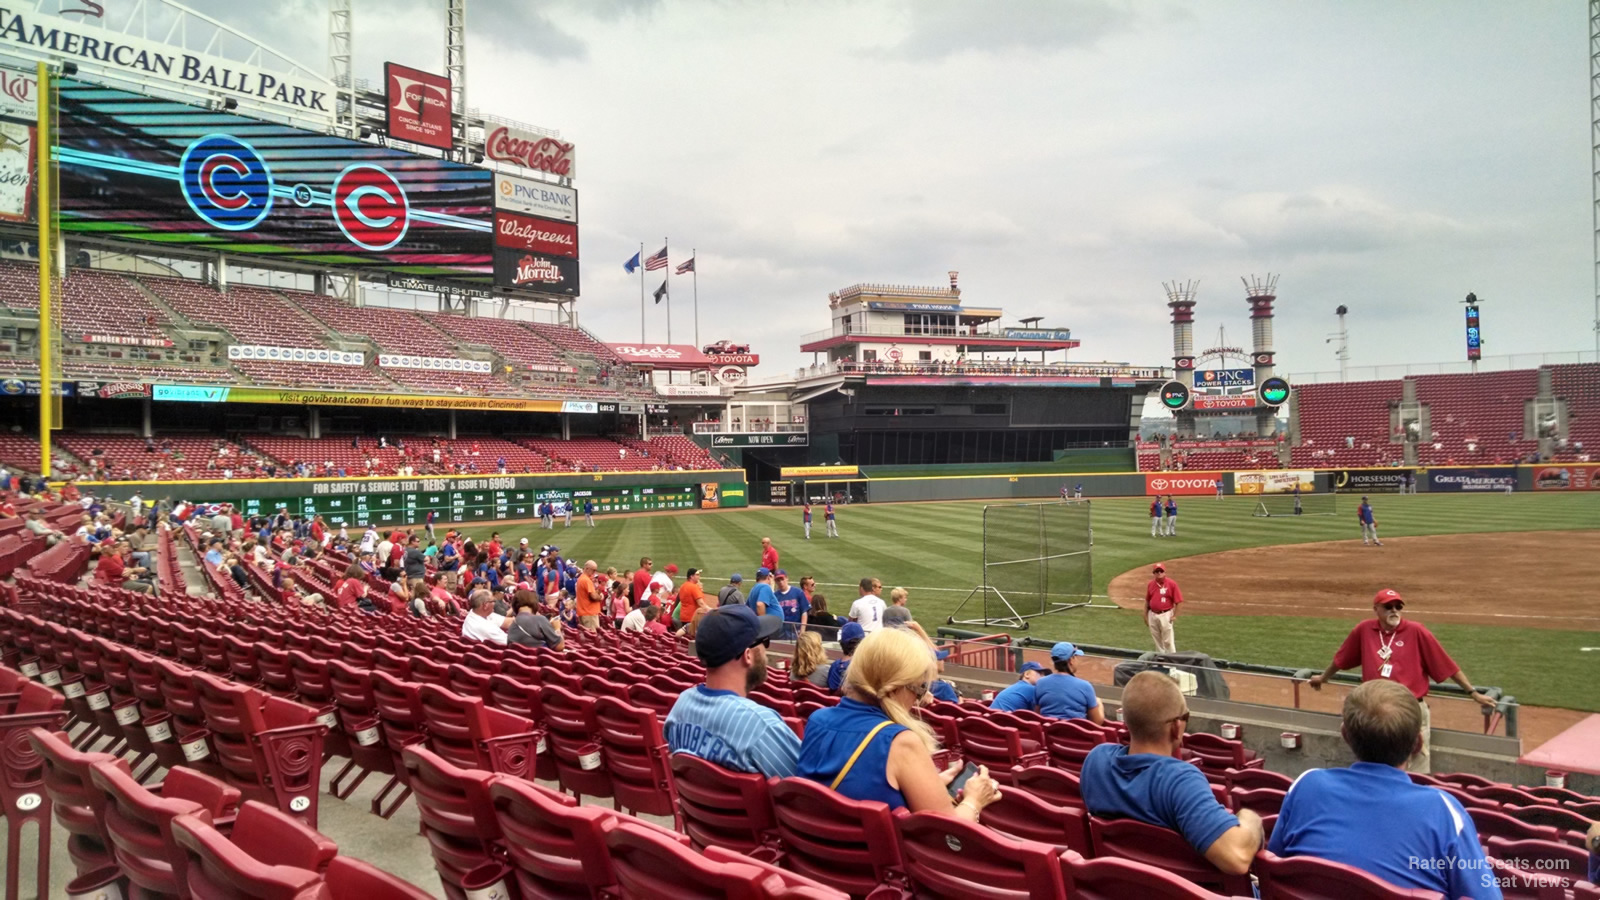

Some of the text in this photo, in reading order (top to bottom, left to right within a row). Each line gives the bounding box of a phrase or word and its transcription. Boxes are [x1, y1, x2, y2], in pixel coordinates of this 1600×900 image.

[0, 14, 329, 113] AMERICAN BALL PARK
[398, 116, 443, 131] CINCINATIANS
[405, 124, 423, 133] SINCE
[486, 126, 576, 176] Coca-Cola
[296, 190, 310, 198] VS
[514, 184, 572, 207] PNC BANK
[498, 218, 574, 245] Walgreens
[530, 257, 551, 269] John
[512, 265, 564, 284] Morrell
[390, 280, 490, 298] ULTIMATE AIR SHUTTLE
[92, 335, 120, 343] KROGER
[1006, 328, 1071, 340] Cincinnati Bell
[615, 346, 682, 357] Reds
[719, 355, 754, 363] TOYOTA
[1216, 370, 1244, 381] PNC
[279, 392, 527, 409] Visit govibrant.com for fun ways to stay active in Cincinnati!
[748, 435, 774, 444] NOW OPEN
[1169, 479, 1216, 489] TOYOTA
[1434, 474, 1505, 485] GREAT AMERICA
[313, 483, 329, 494] FOR
[330, 482, 360, 494] SAFETY
[360, 484, 367, 492] &
[367, 482, 400, 492] SERVICE
[400, 481, 418, 491] TEXT
[457, 480, 477, 490] ISSUE
[479, 479, 488, 489] TO
[488, 477, 516, 490] 69050
[357, 495, 367, 503] PIT
[536, 492, 570, 500] ULTIMATE
[872, 606, 878, 622] 1
[669, 721, 741, 772] ANDBERG
[24, 796, 34, 806] O
[296, 798, 304, 808] N
